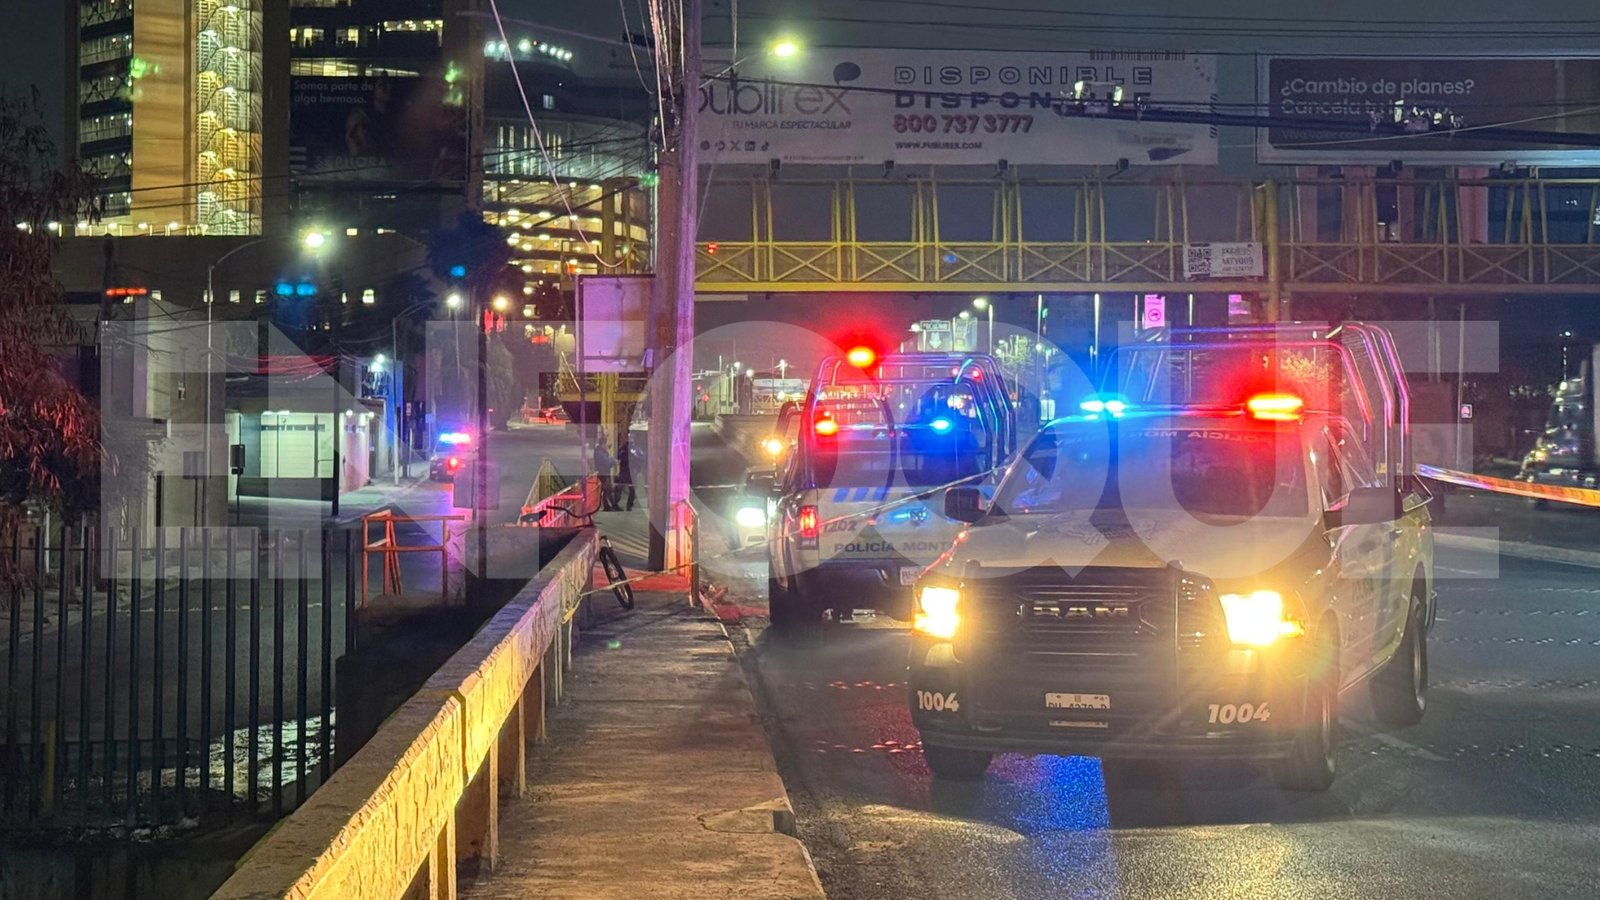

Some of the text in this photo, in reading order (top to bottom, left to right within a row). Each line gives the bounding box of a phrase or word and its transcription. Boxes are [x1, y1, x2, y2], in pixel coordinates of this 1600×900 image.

[894, 66, 1152, 85] DISPONIBLE
[294, 80, 374, 92] Somos parte de
[1281, 77, 1475, 99] ¿Cambio de planes?
[745, 121, 778, 129] MARCA
[780, 121, 851, 129] ESPECTACULAR
[894, 114, 1034, 133] 800 737 3777
[834, 540, 895, 553] POLICÍA
[917, 690, 1271, 726] 1004 1004
